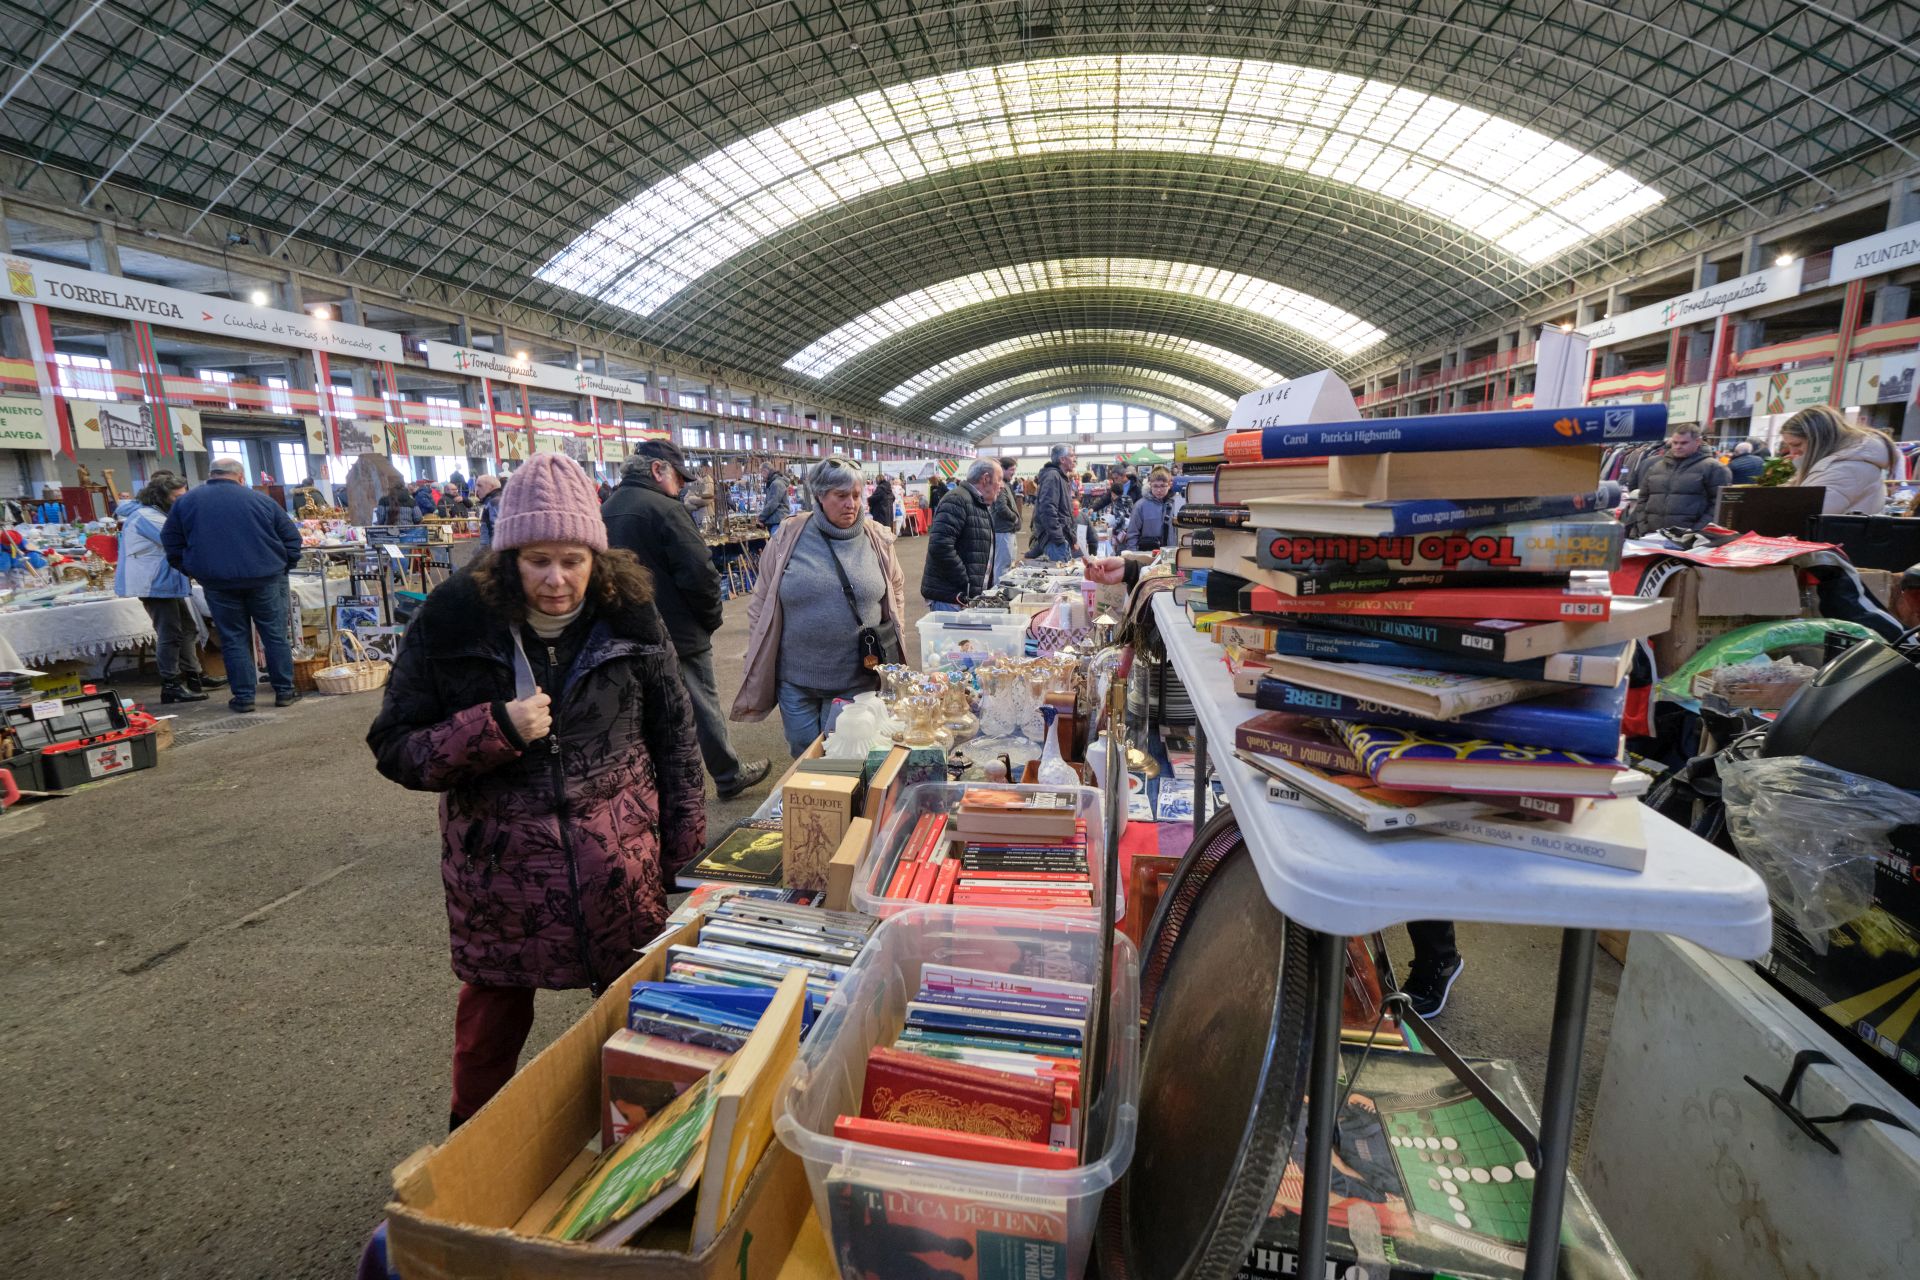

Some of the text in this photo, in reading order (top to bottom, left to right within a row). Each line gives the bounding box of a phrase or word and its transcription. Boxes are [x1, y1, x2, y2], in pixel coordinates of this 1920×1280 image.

[1853, 239, 1920, 269] AYUNTAM
[44, 279, 184, 319] TORRELAVEGA
[223, 313, 373, 351] Ciudad de Ferias y Mercados
[1258, 395, 1264, 406] 1
[1264, 392, 1274, 404] X
[1283, 433, 1309, 446] Carol
[1320, 431, 1353, 444] Patricia
[1354, 428, 1402, 443] Highsmith
[1411, 510, 1434, 525] Como
[1433, 509, 1451, 523] agua
[1450, 508, 1466, 522] para
[1465, 504, 1496, 519] chocolate
[1192, 538, 1215, 546] cantes
[1269, 535, 1522, 567] Todo incluido
[1336, 600, 1383, 611] CARLOS
[1383, 600, 1416, 611] JUAN
[1425, 626, 1438, 642] LA
[1284, 687, 1343, 711] FIEBRE
[1246, 736, 1272, 750] Straub
[1271, 742, 1293, 758] Peter
[789, 793, 844, 809] EL QUIJOTE
[1472, 825, 1483, 835] LA
[1485, 826, 1513, 840] BRASA
[1530, 835, 1562, 850] EMILIO
[1562, 841, 1607, 859] ROMERO
[863, 1191, 1055, 1236] T. LUCA DE TENA
